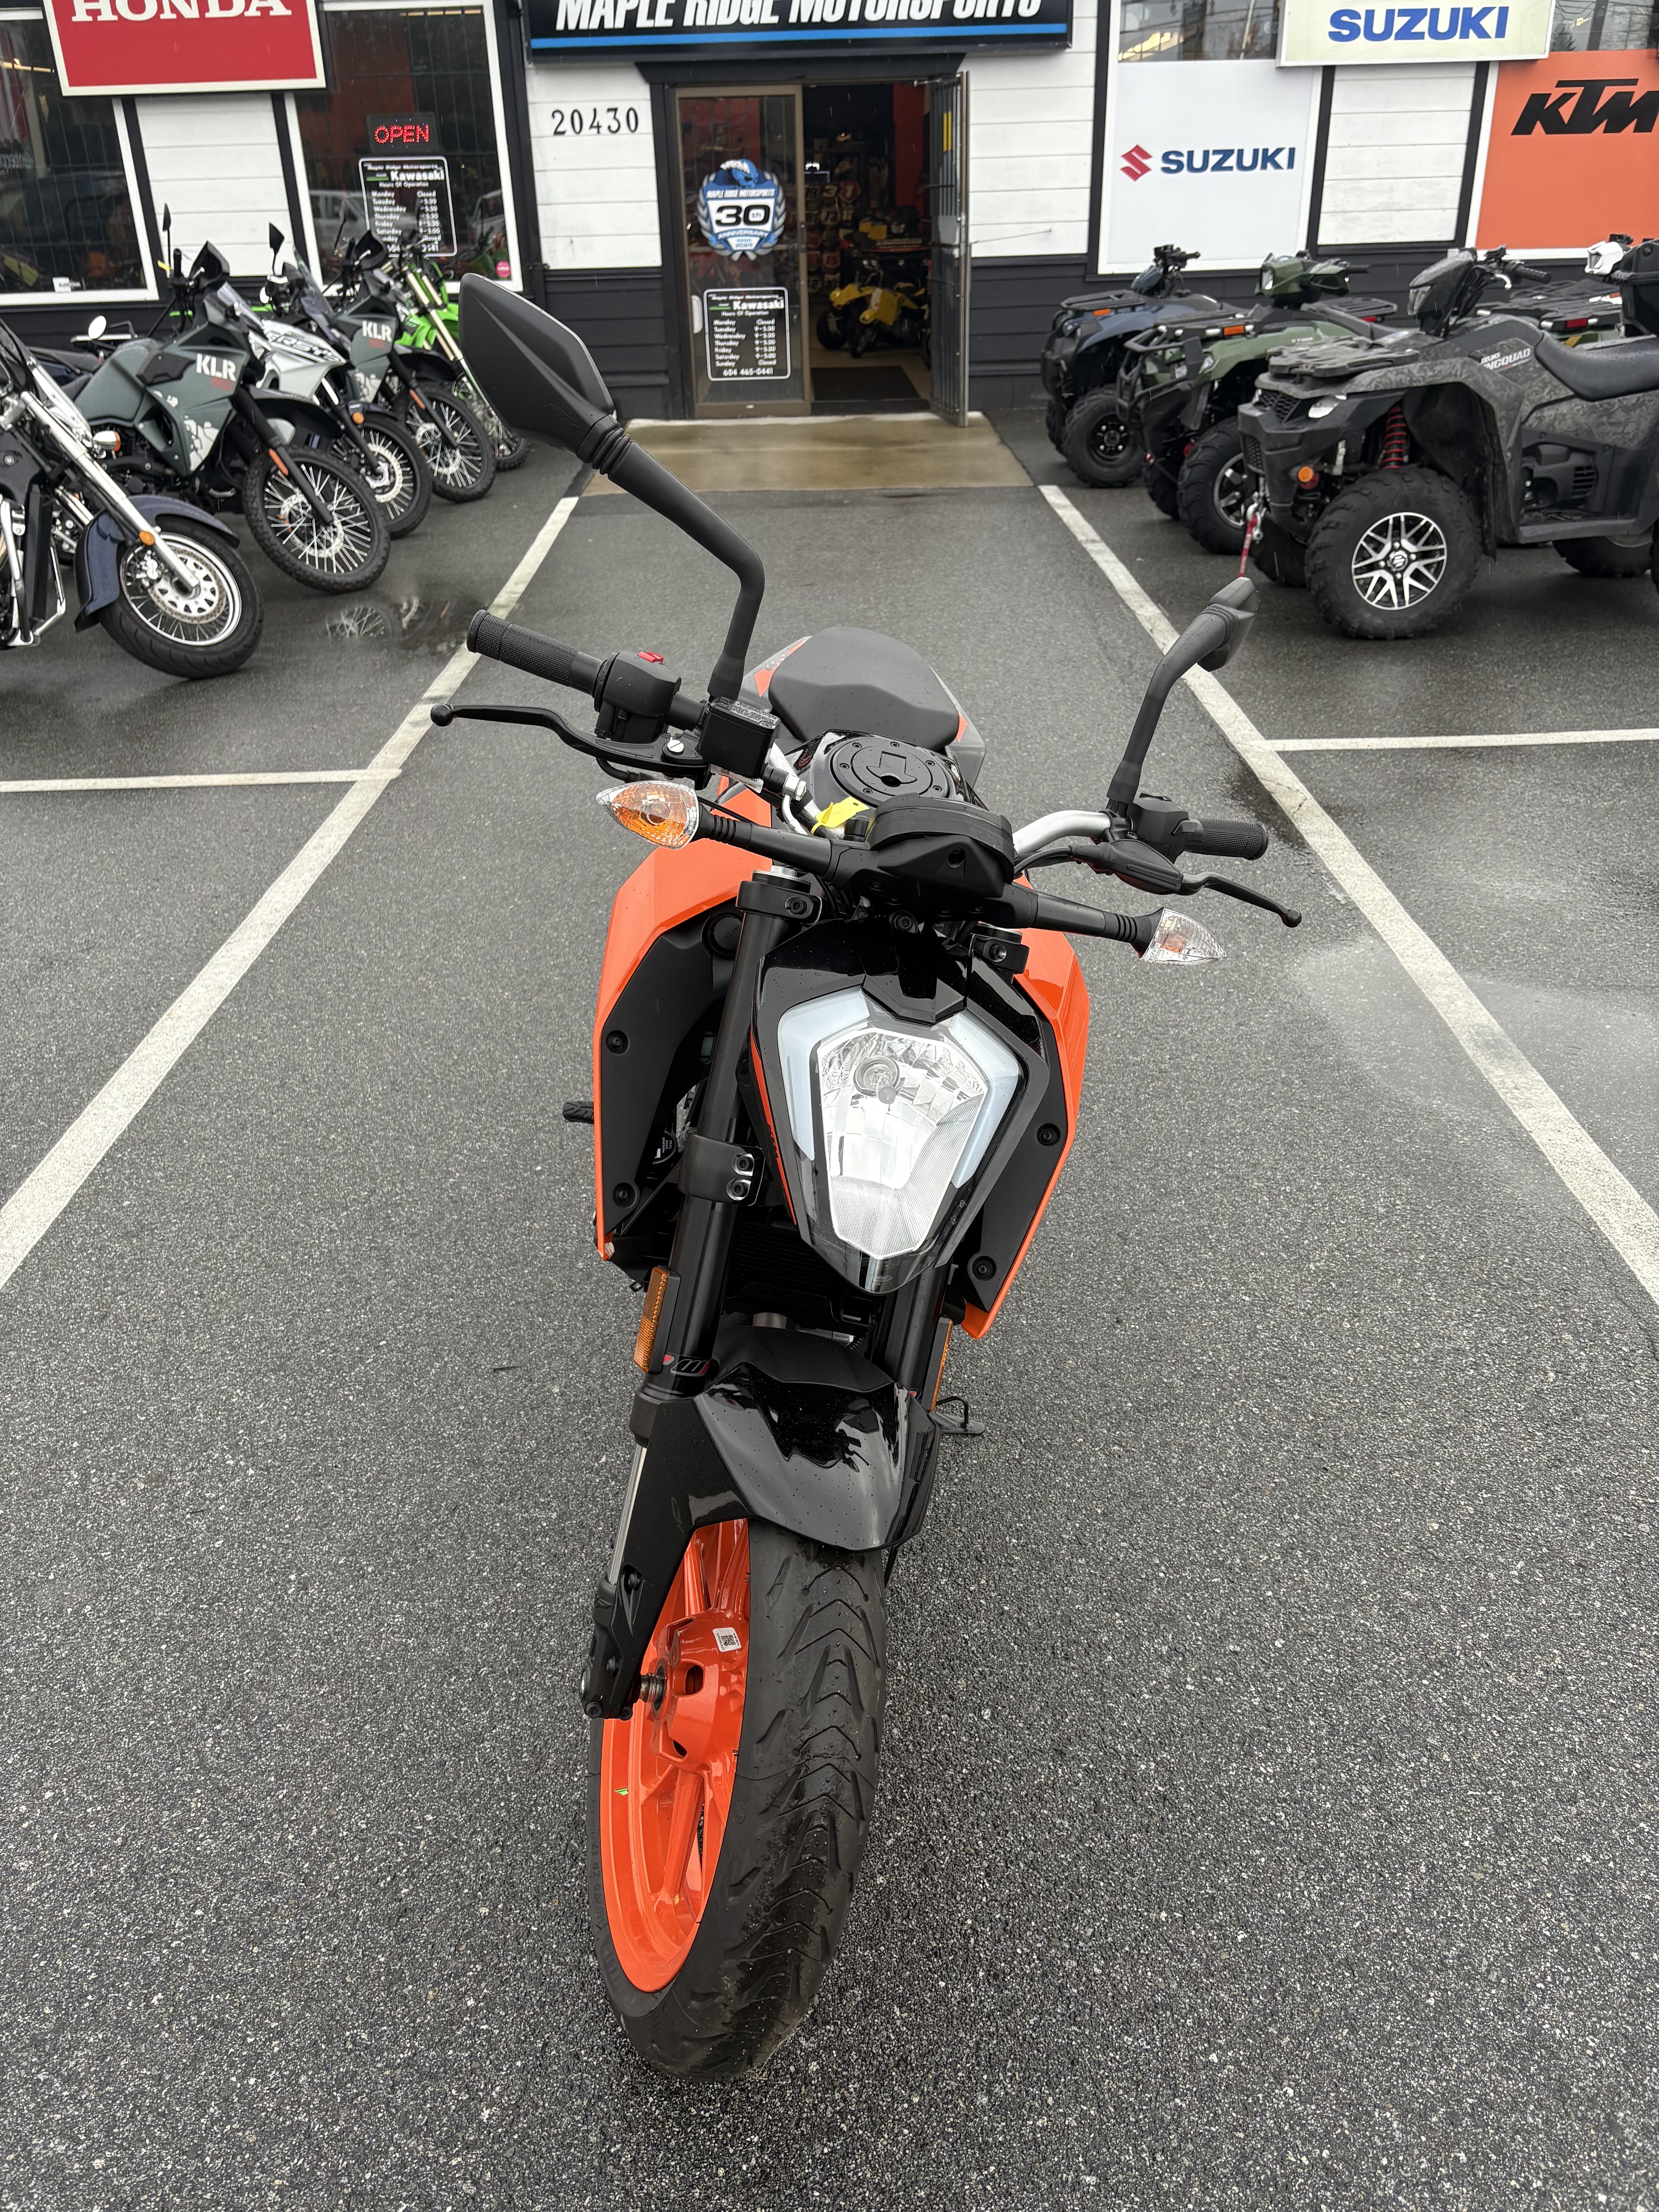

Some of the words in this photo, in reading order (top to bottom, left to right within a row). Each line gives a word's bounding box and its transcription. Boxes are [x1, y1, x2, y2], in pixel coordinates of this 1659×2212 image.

[71, 0, 292, 22] HONDA
[555, 0, 674, 31] MAPLE
[1328, 6, 1510, 42] SUZUKI
[1510, 79, 1659, 136] KTM
[551, 107, 639, 136] 20430
[374, 124, 429, 144] OPEN
[1160, 147, 1296, 174] SUZUKI
[390, 169, 445, 181] Kawasaki
[716, 205, 770, 226] 30
[733, 299, 785, 310] Kawasaki
[362, 320, 393, 343] KLR
[196, 353, 237, 382] KLR
[592, 1862, 600, 1879] ZR
